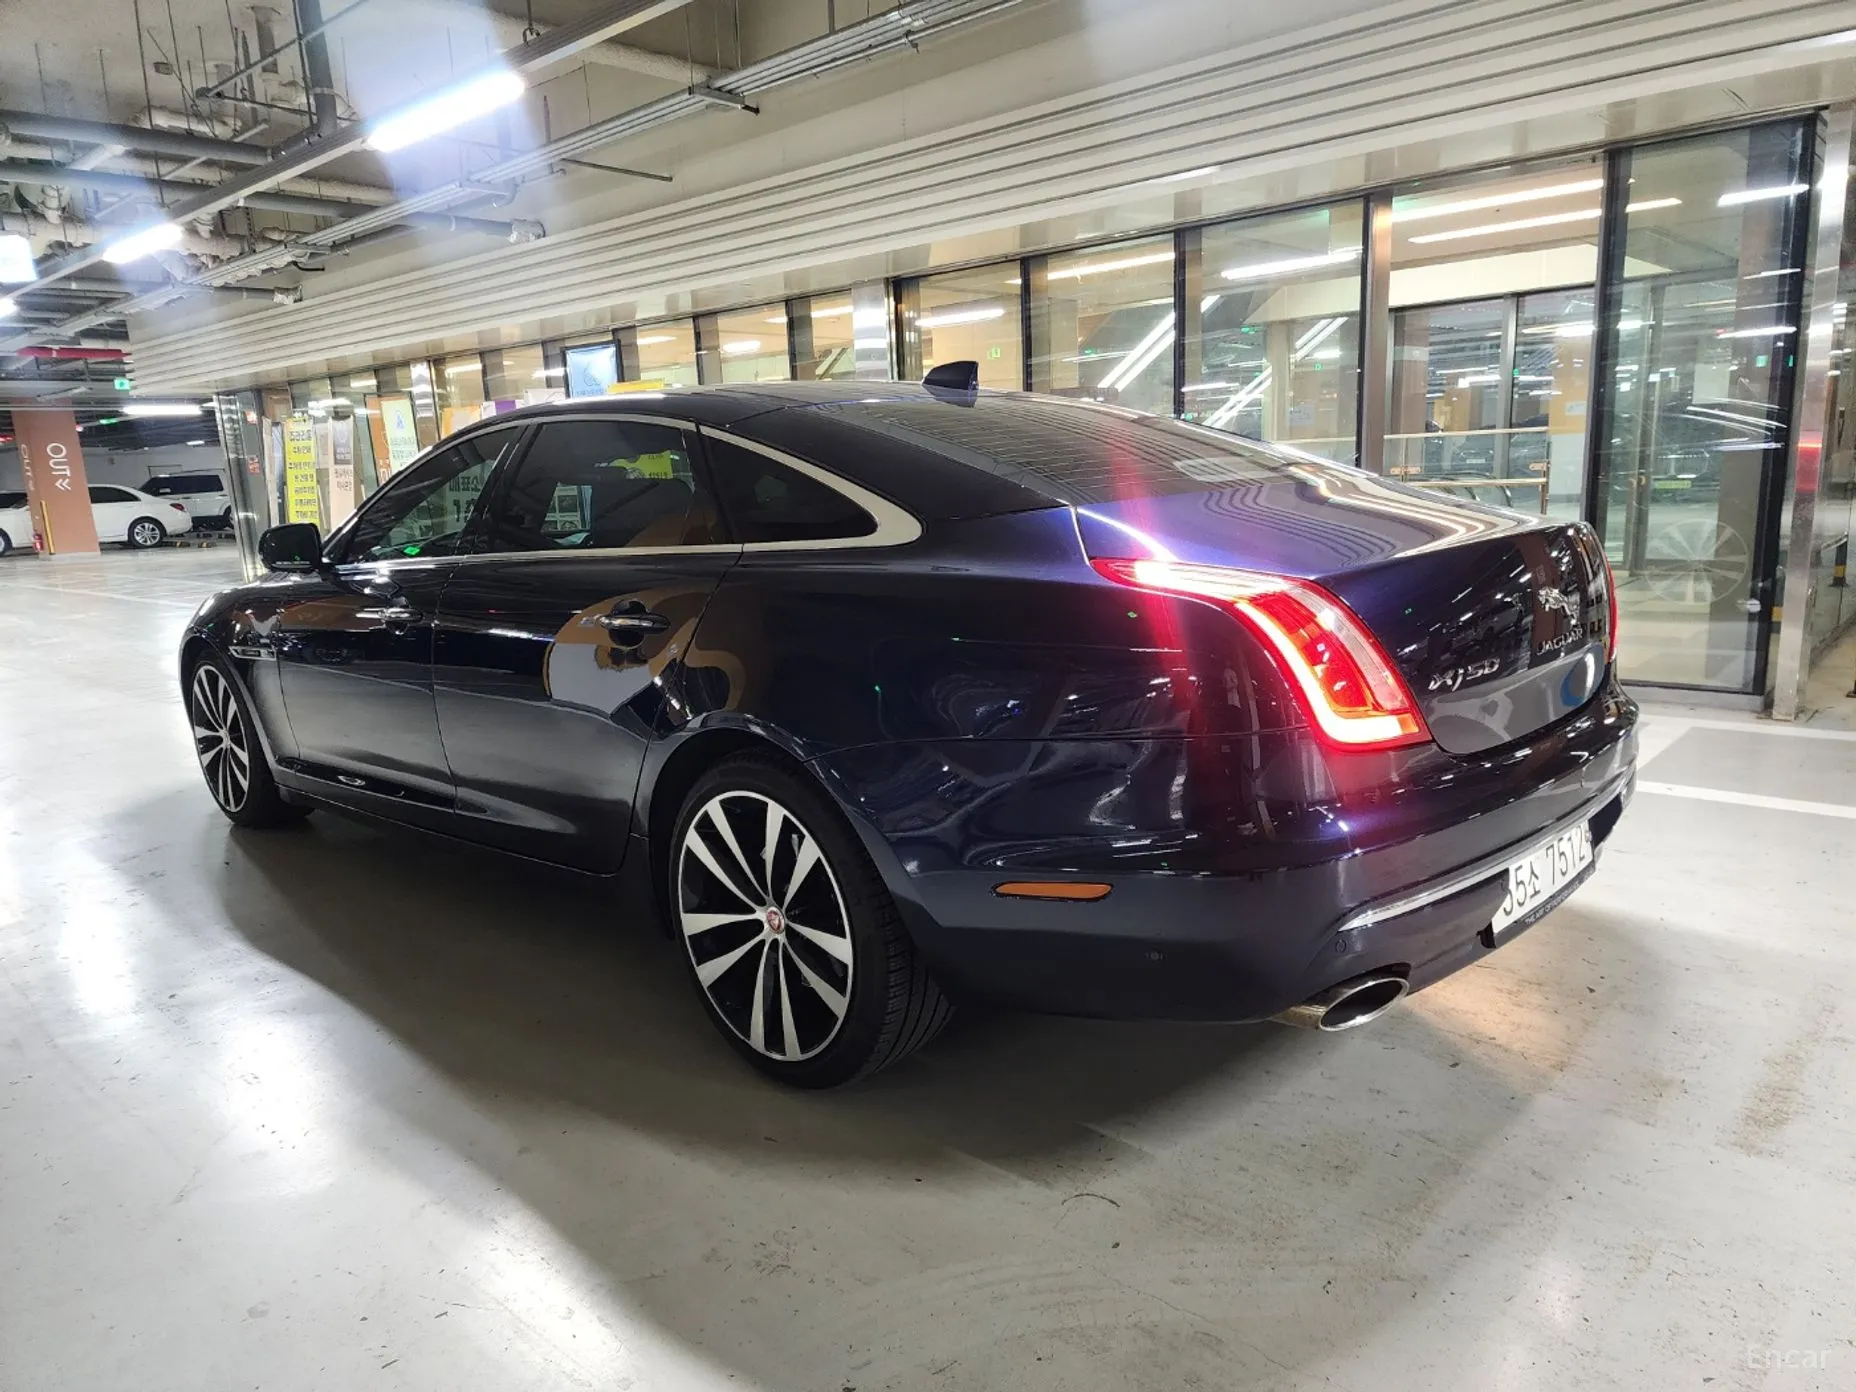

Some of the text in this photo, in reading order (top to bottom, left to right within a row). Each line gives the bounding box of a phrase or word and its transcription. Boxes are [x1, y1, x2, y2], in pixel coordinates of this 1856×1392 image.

[46, 442, 71, 477] OUT
[1536, 628, 1583, 656] JAGUAR
[1546, 825, 1586, 885] 7512
